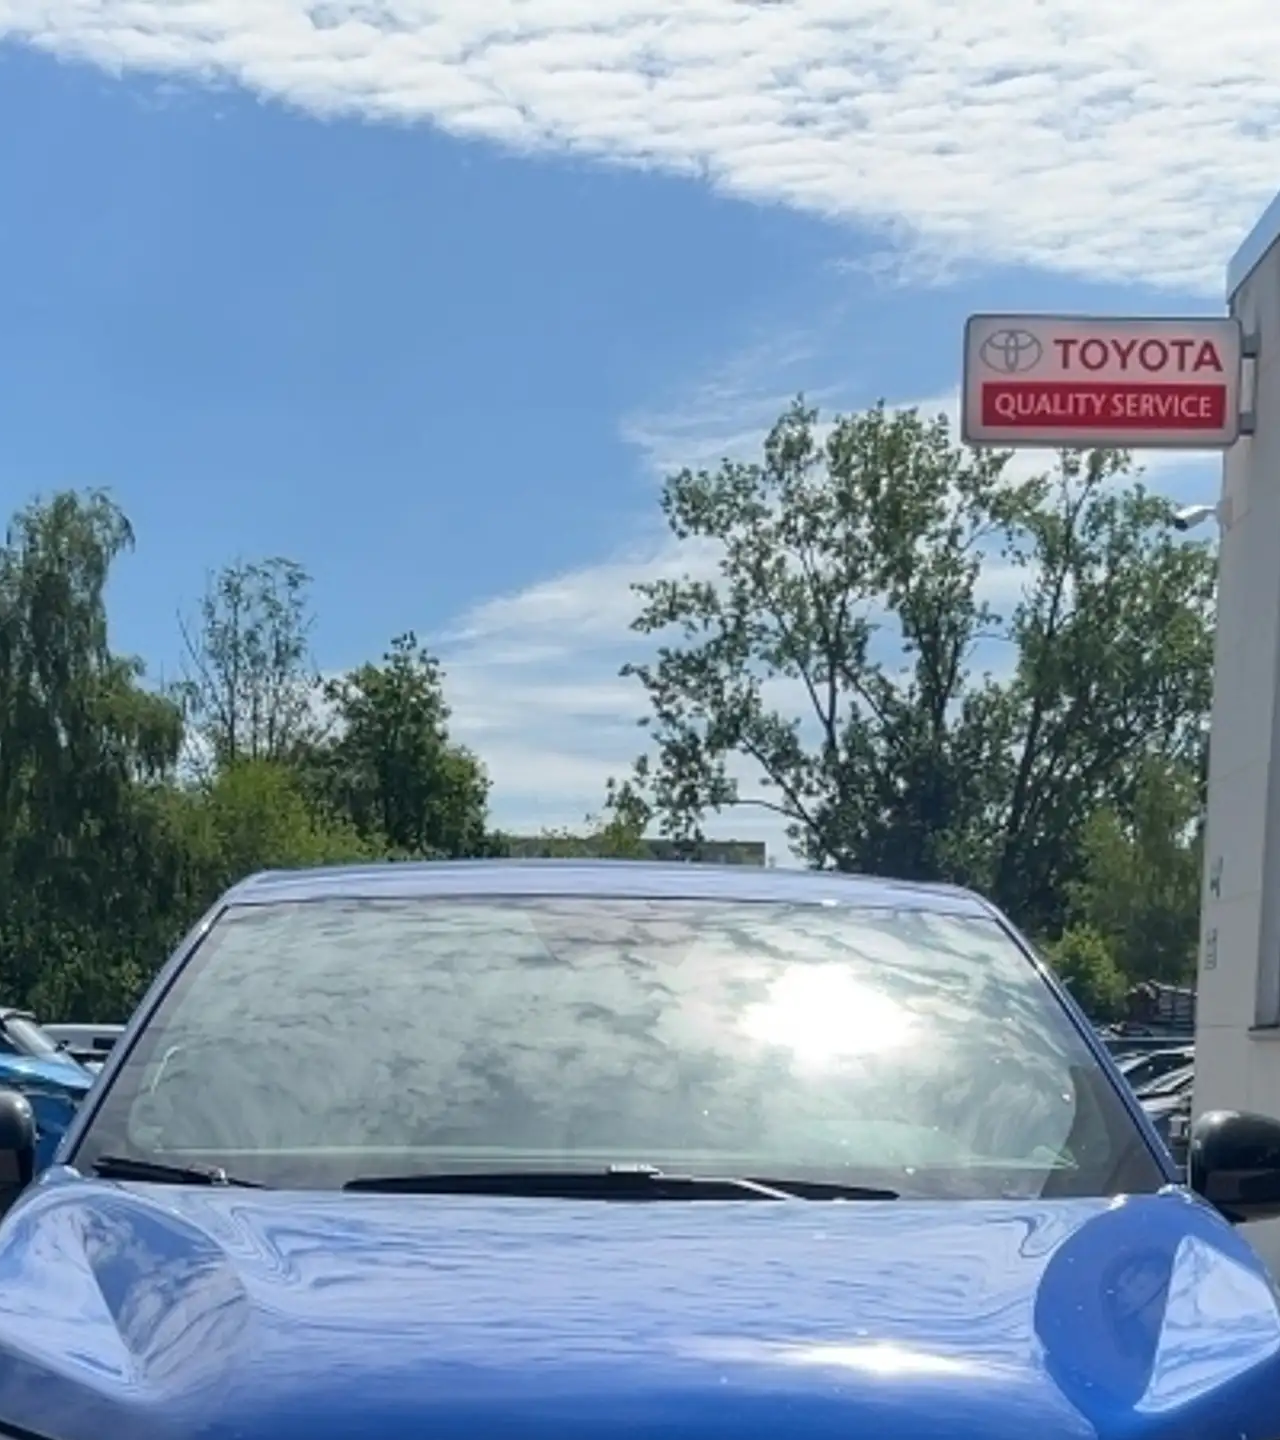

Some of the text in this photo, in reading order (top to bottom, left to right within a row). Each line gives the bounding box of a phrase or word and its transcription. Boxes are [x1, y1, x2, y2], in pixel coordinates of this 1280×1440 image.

[1053, 338, 1223, 373] TOYOTA
[994, 391, 1212, 420] QUALITY SERVICE
